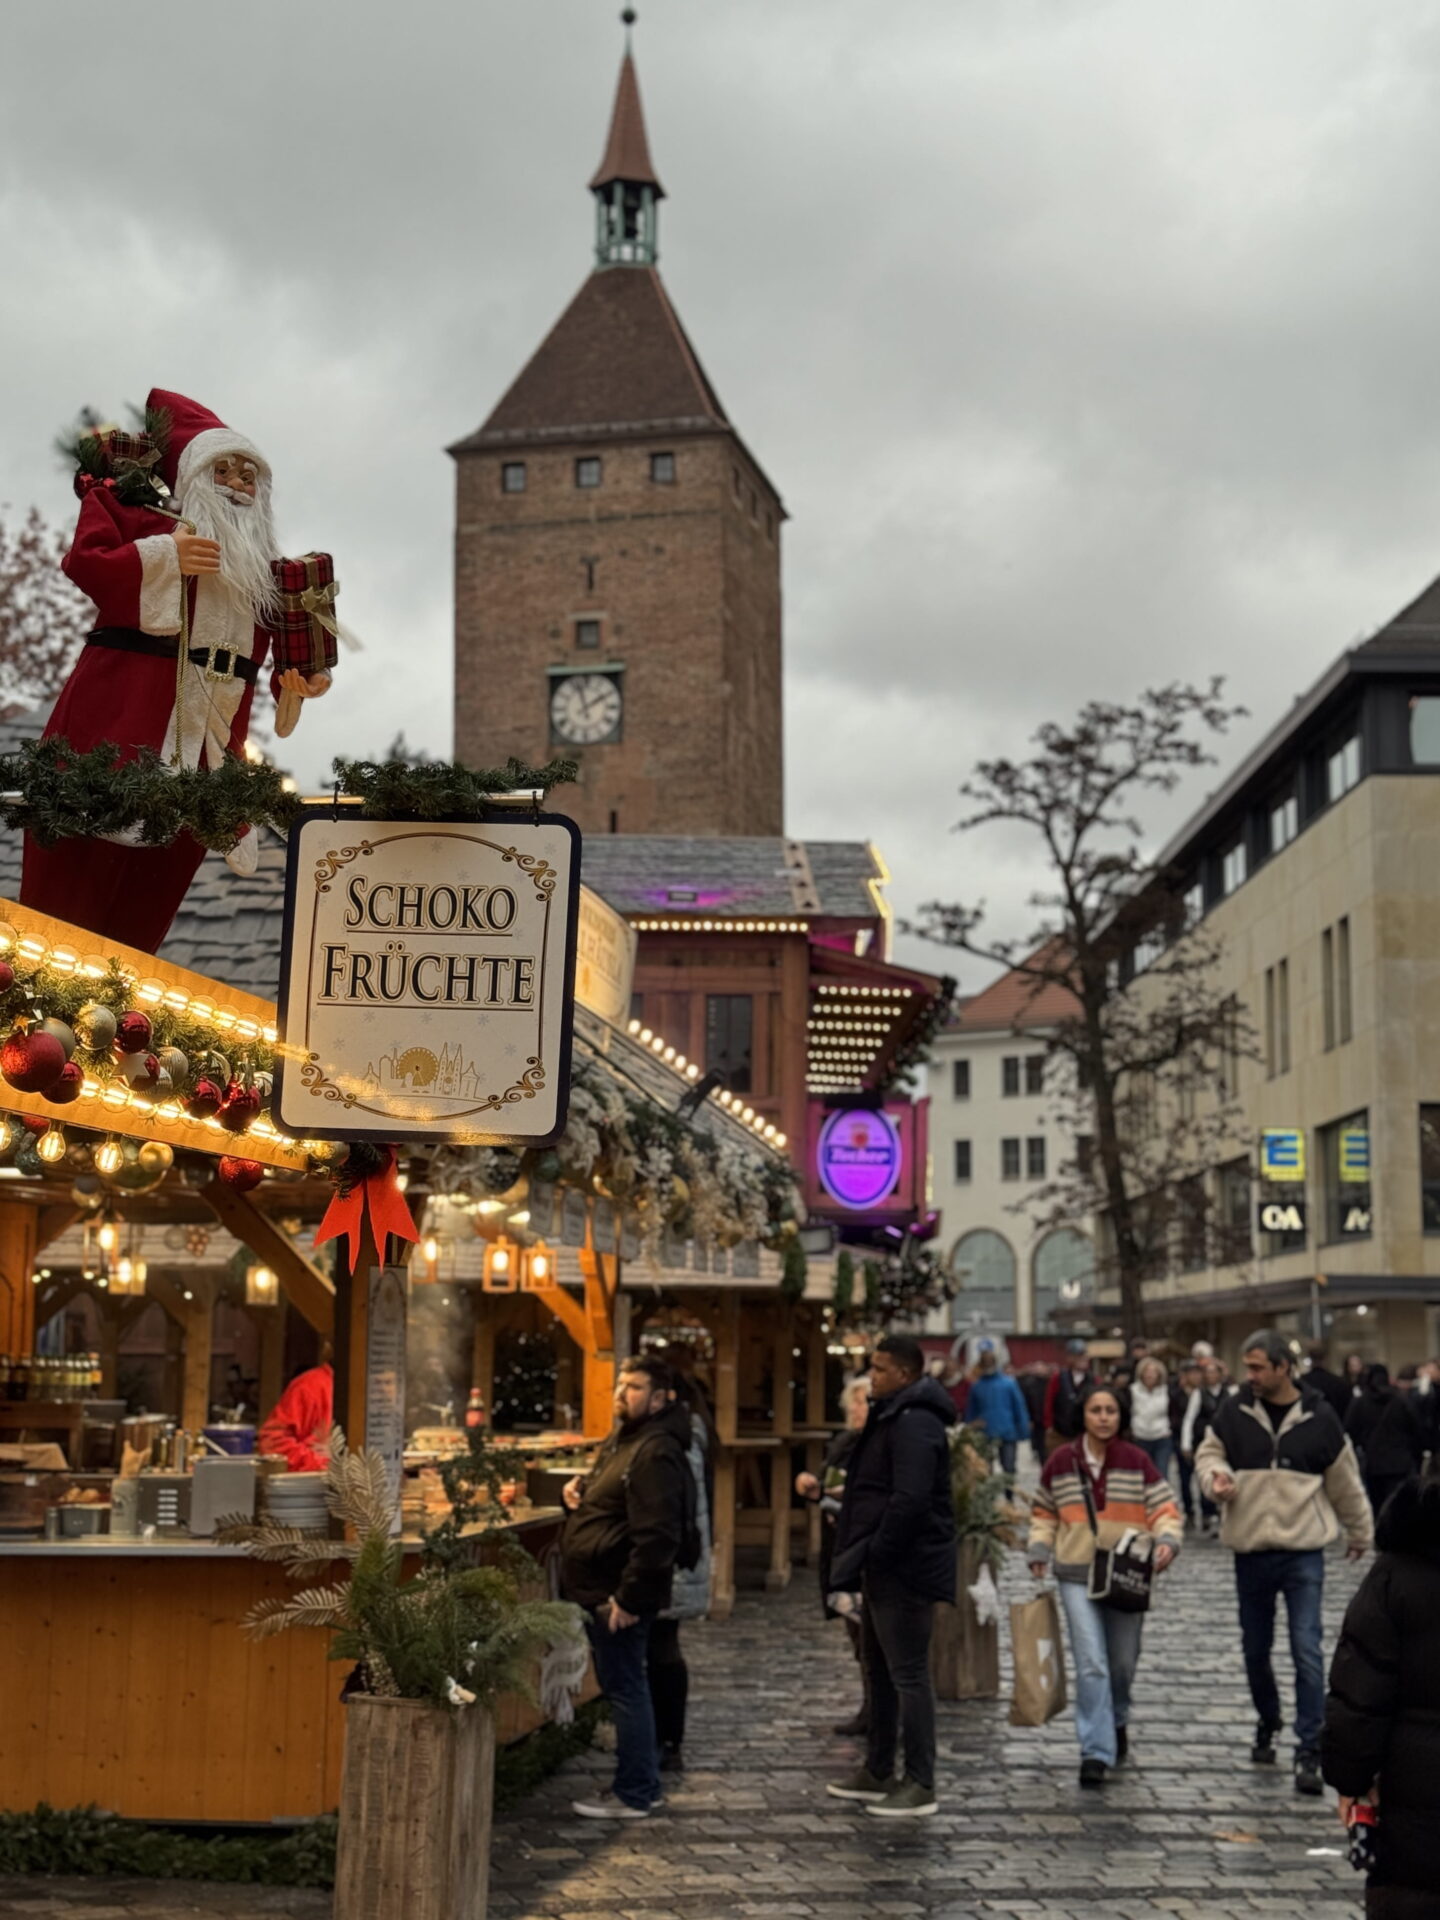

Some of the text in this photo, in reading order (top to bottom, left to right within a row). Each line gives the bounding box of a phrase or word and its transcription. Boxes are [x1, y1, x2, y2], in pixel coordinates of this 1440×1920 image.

[345, 875, 517, 931] SCHOKO
[318, 941, 536, 1005] FRÜCHTE
[1263, 1135, 1298, 1166] E
